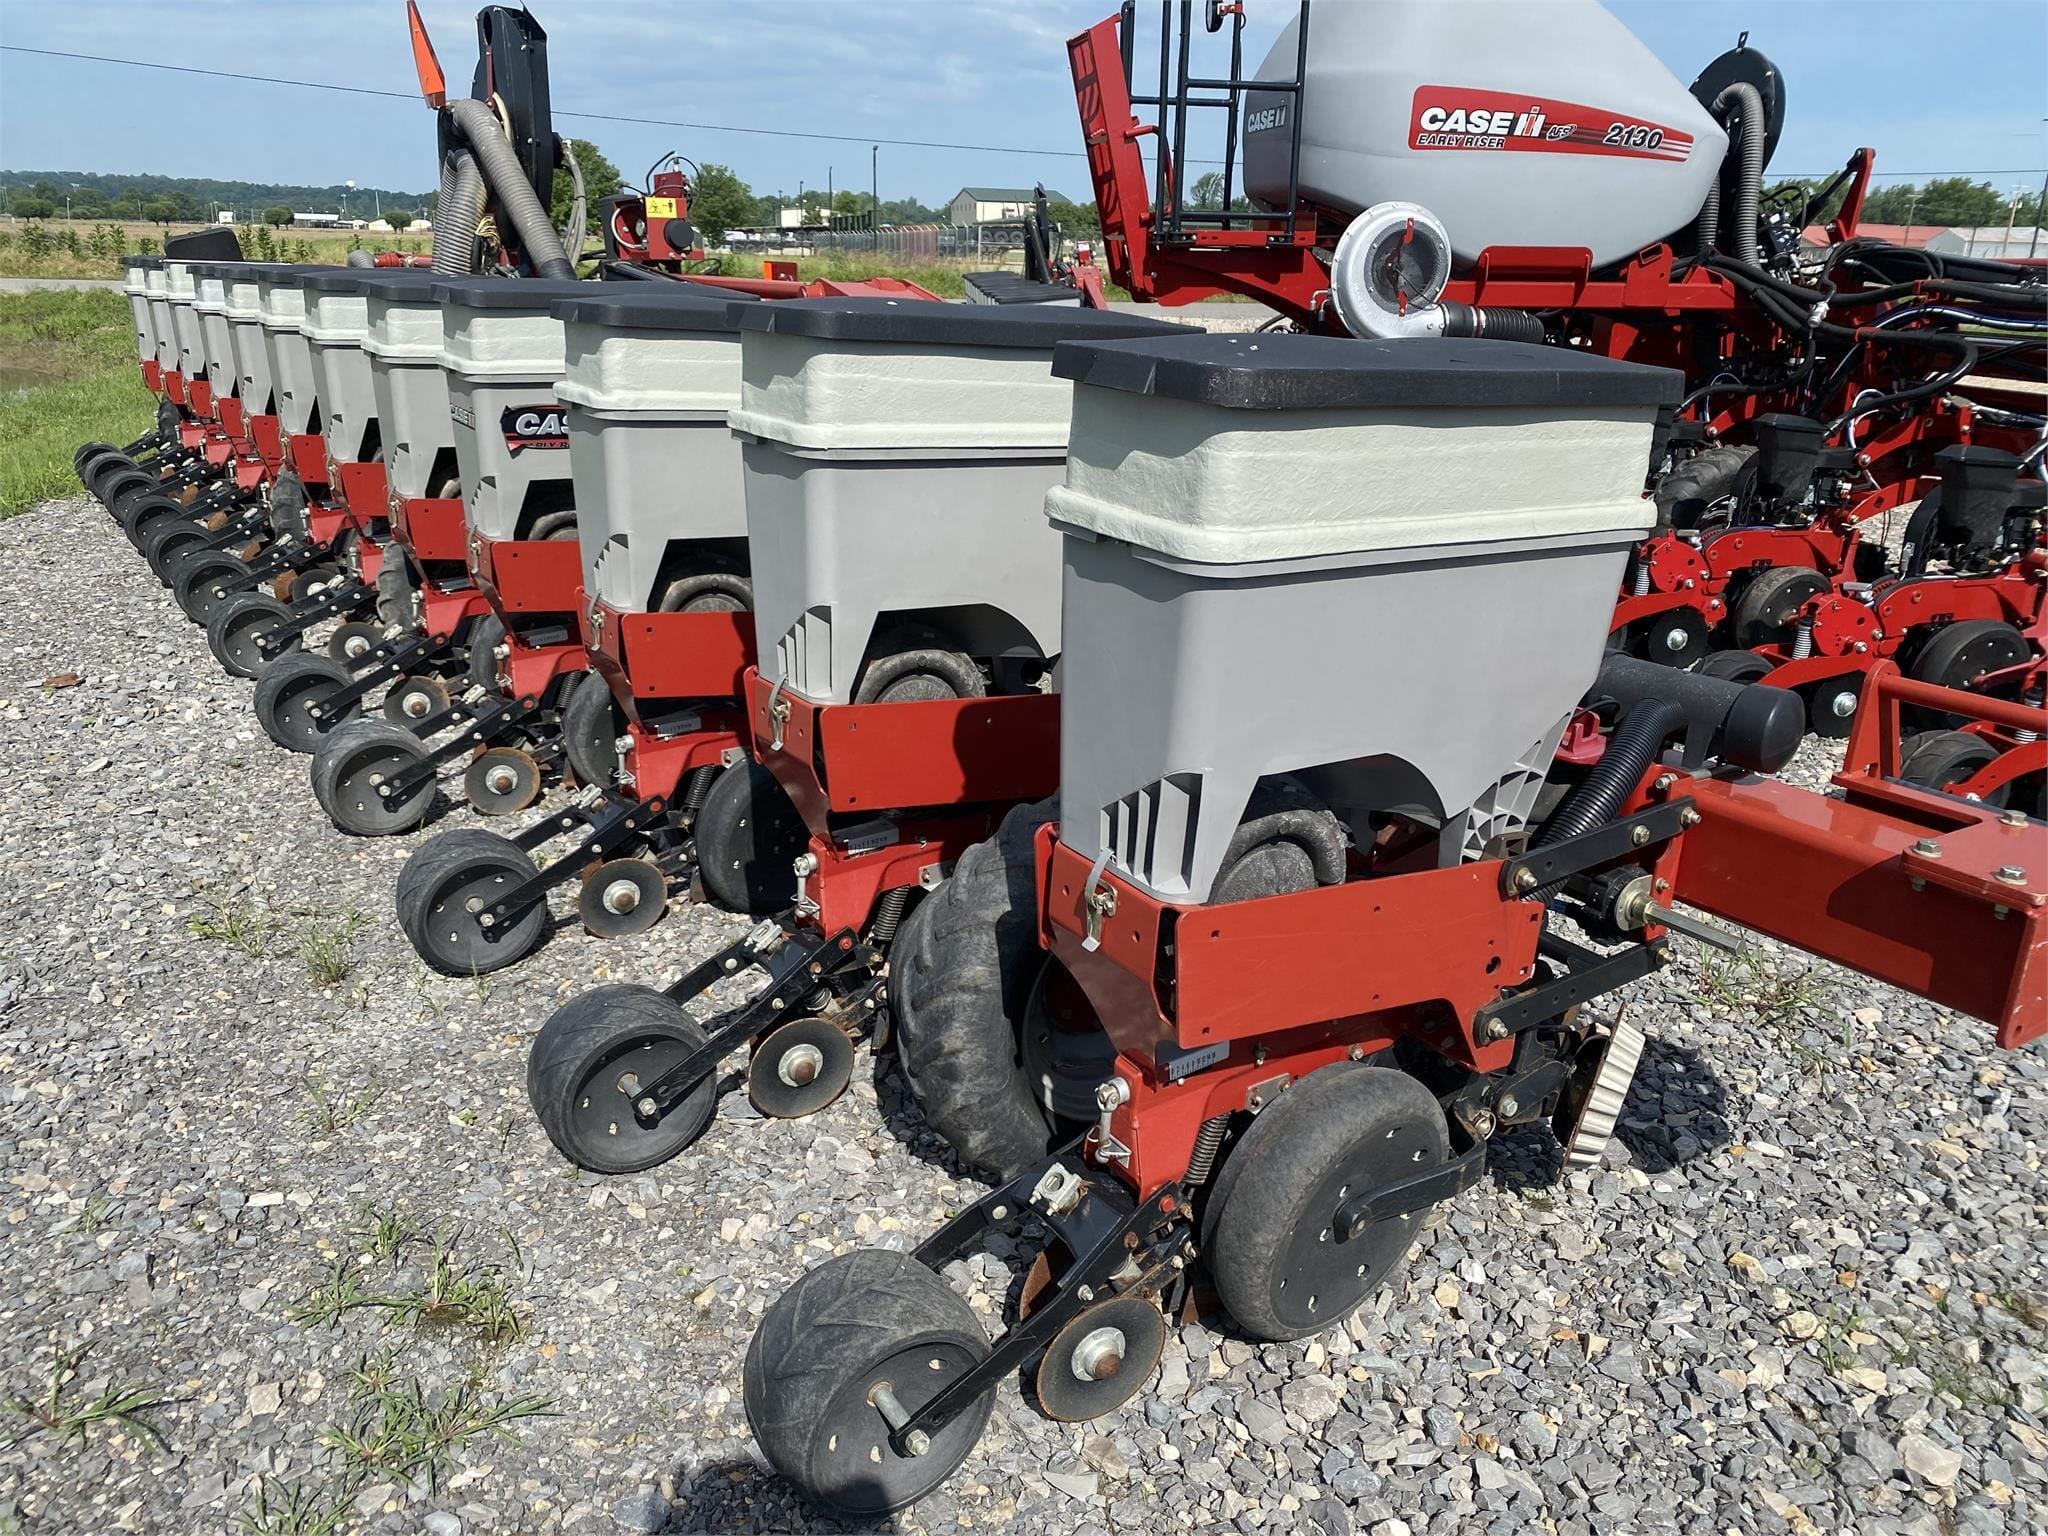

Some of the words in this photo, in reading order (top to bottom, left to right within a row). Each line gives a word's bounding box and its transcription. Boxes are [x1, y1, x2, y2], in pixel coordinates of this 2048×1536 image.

[1248, 109, 1275, 133] CASE
[1420, 106, 1514, 135] CASE
[1548, 125, 1571, 137] AFS
[1416, 133, 1464, 146] EARLY
[1465, 135, 1505, 148] RISER
[1603, 122, 1664, 149] 2130
